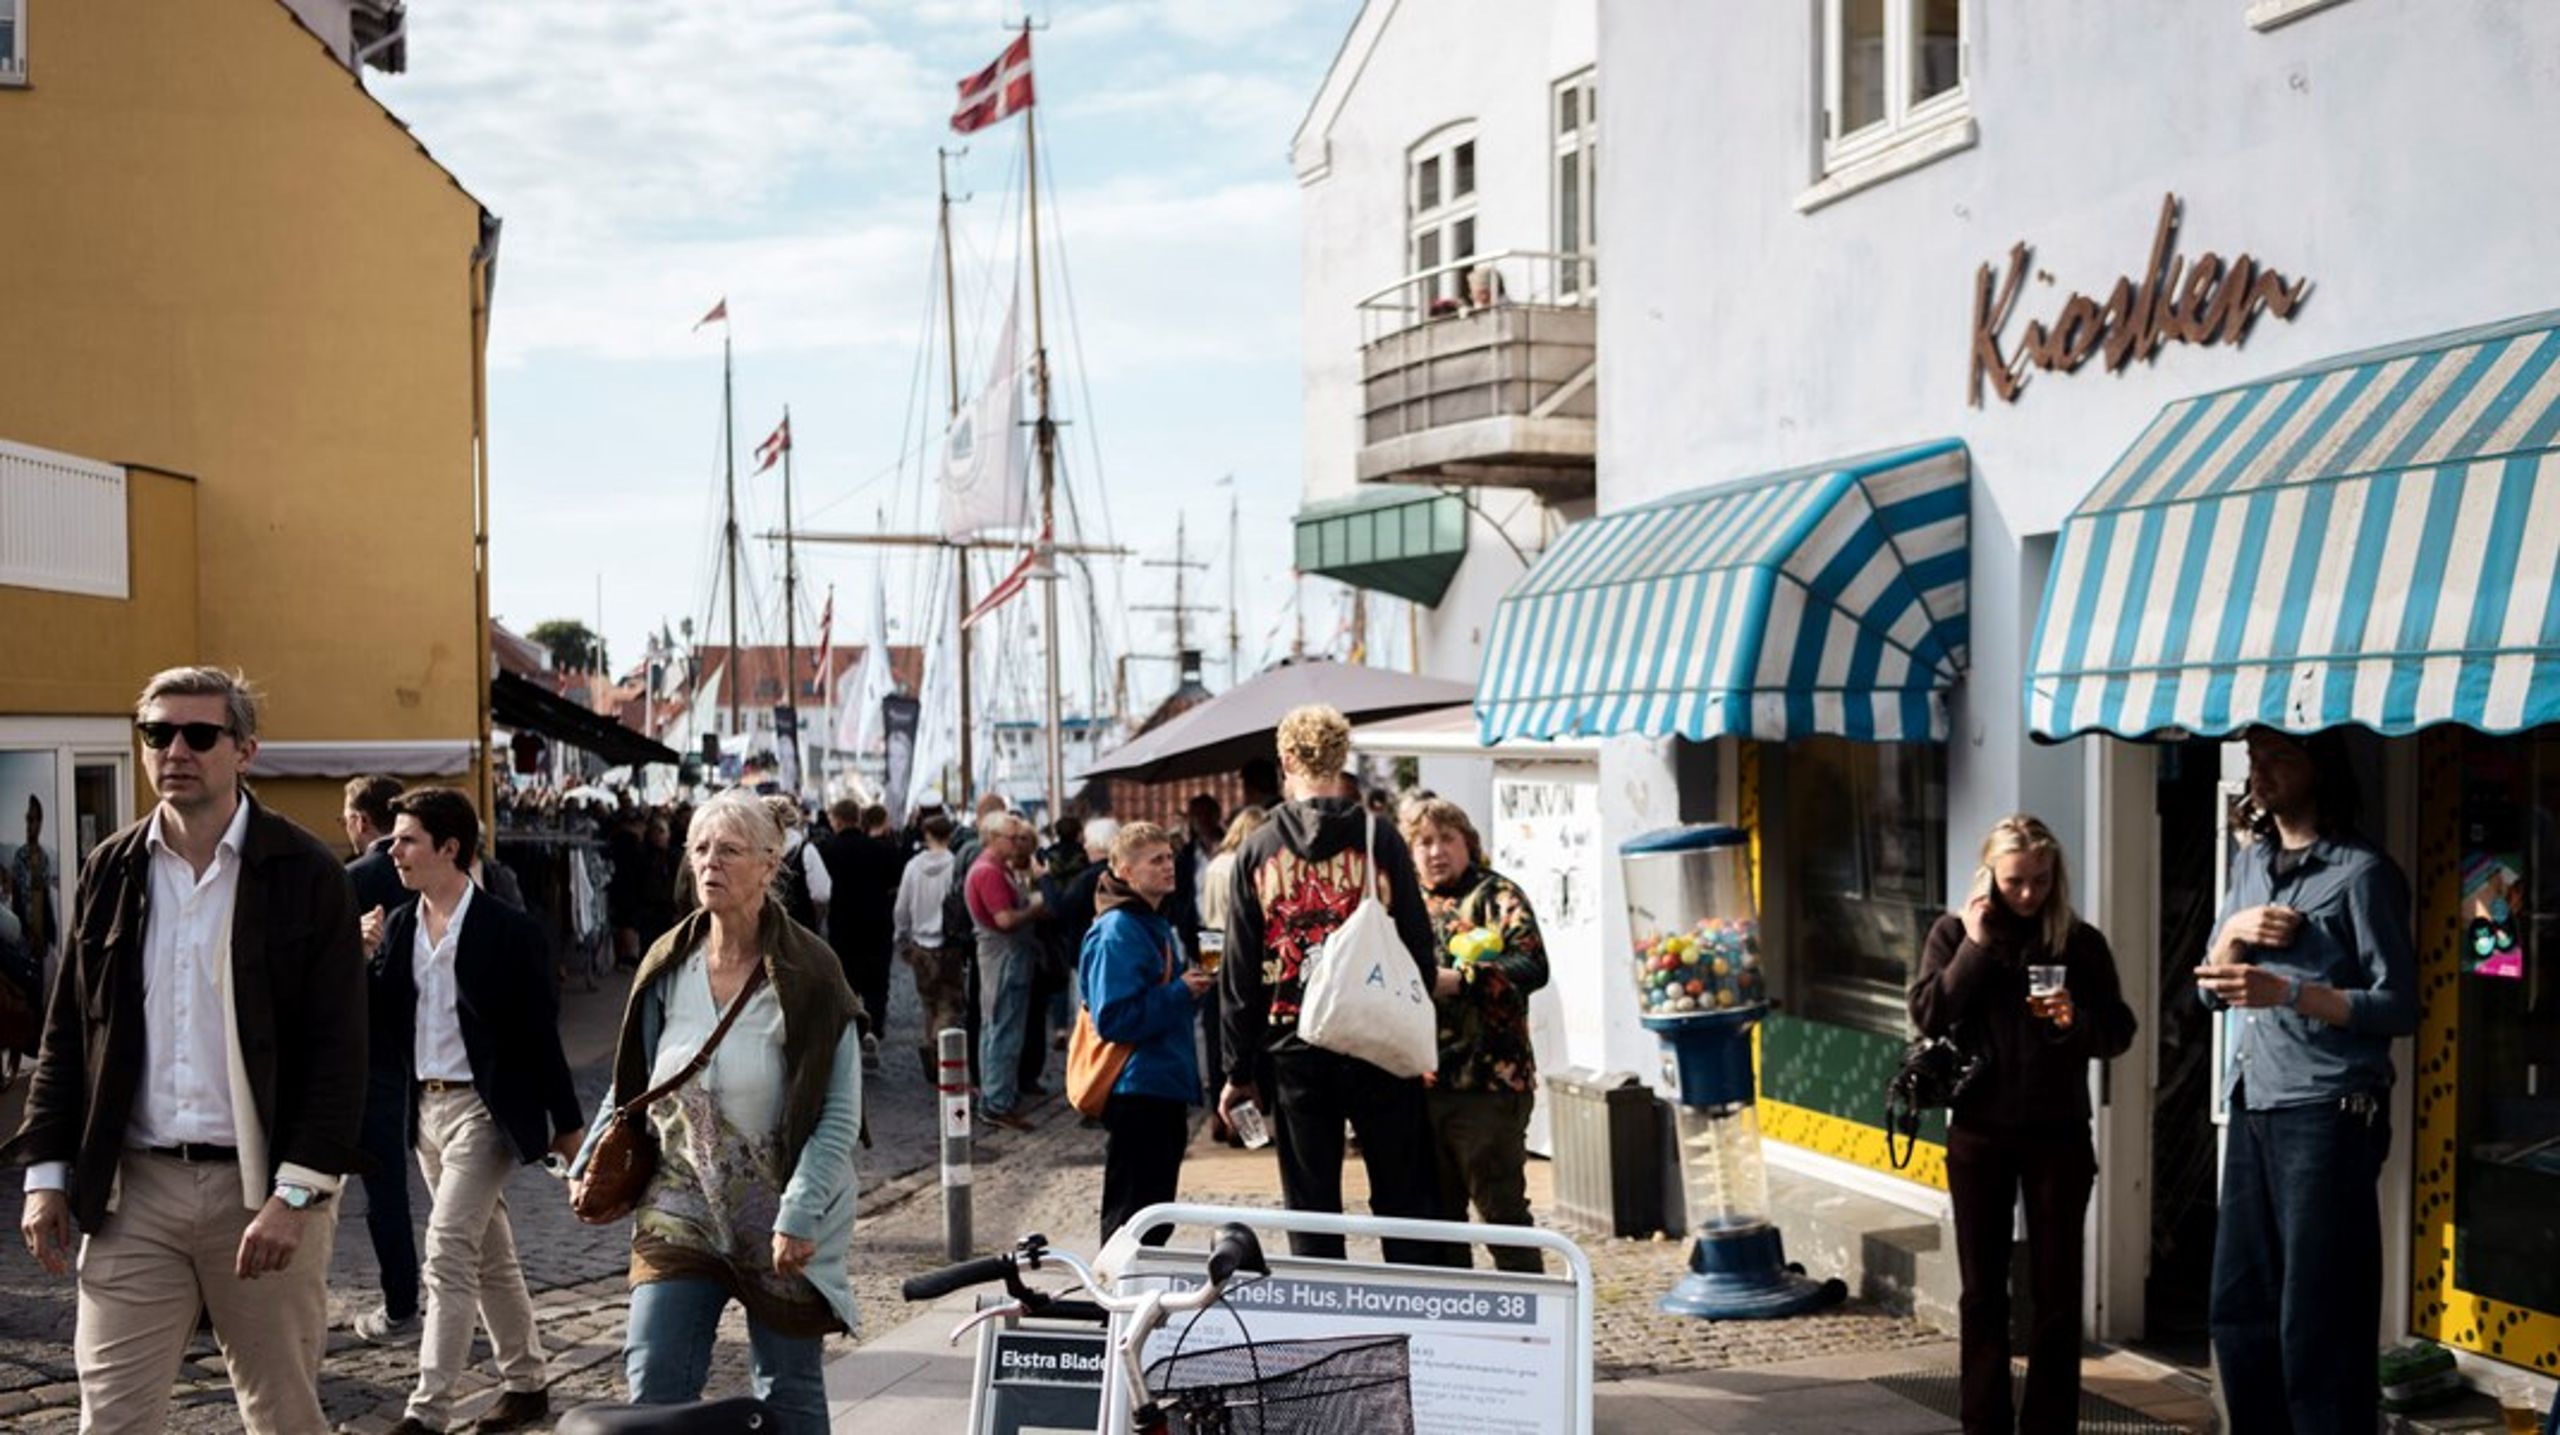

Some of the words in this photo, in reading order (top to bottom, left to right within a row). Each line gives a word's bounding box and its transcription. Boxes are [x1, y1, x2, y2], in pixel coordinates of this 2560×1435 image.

[1970, 188, 2306, 405] Kiosken
[1292, 1283, 1342, 1310] Hus,
[1345, 1286, 1491, 1319] Havnegade
[1496, 1295, 1526, 1318] 38
[1001, 1350, 1056, 1369] Ekstra
